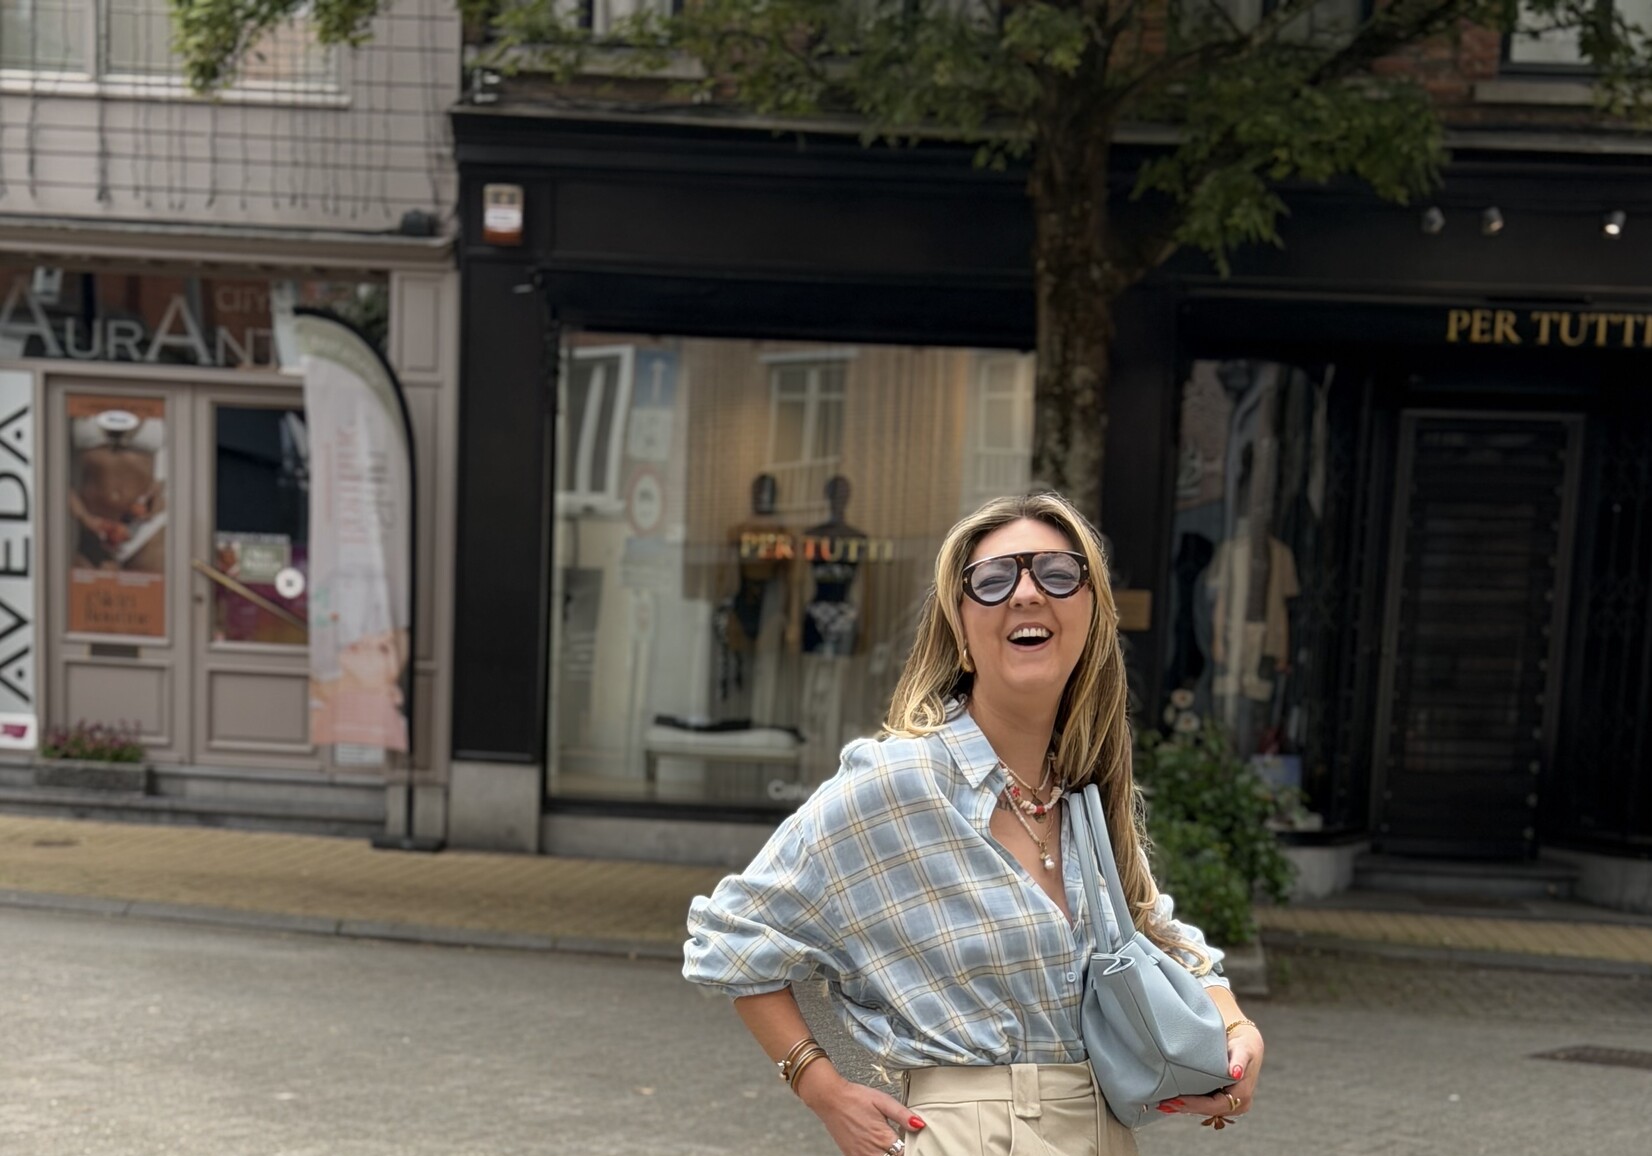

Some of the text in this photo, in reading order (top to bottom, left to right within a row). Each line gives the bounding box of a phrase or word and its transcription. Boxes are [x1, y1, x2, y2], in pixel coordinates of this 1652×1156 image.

[1446, 308, 1652, 347] PER TUTTI
[0, 406, 31, 703] AVEDA
[740, 531, 894, 563] PER TUTTI
